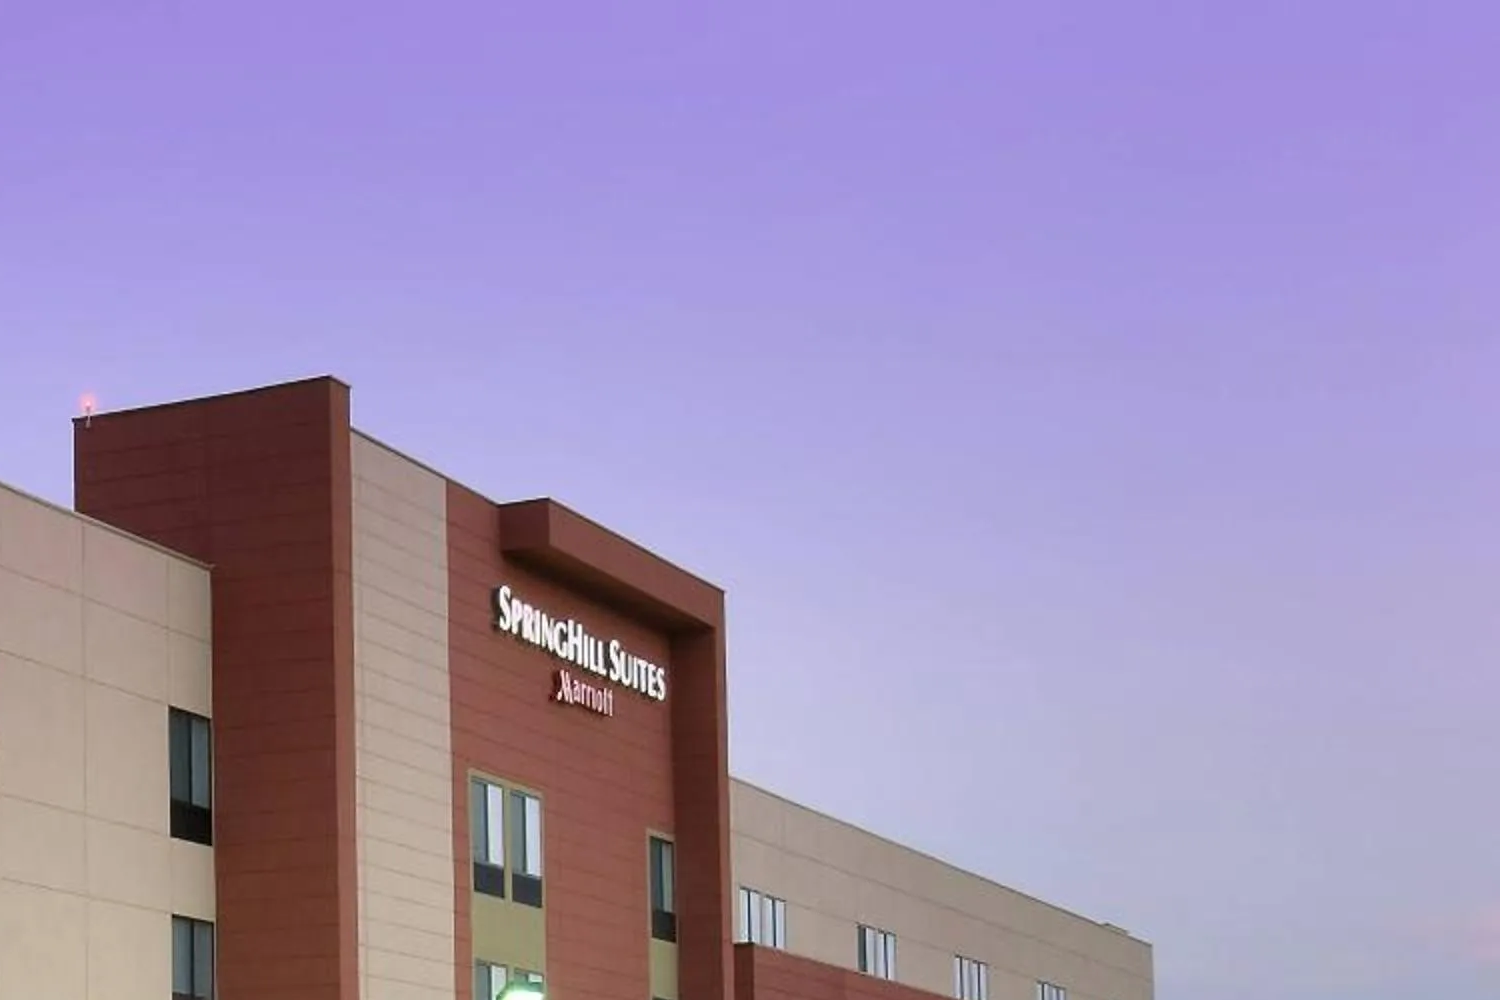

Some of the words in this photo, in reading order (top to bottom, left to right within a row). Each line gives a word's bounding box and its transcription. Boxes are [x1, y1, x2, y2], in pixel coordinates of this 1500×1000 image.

[498, 584, 607, 677] SPRINGHILL
[608, 638, 667, 701] SUITES
[556, 668, 614, 717] Marriott
